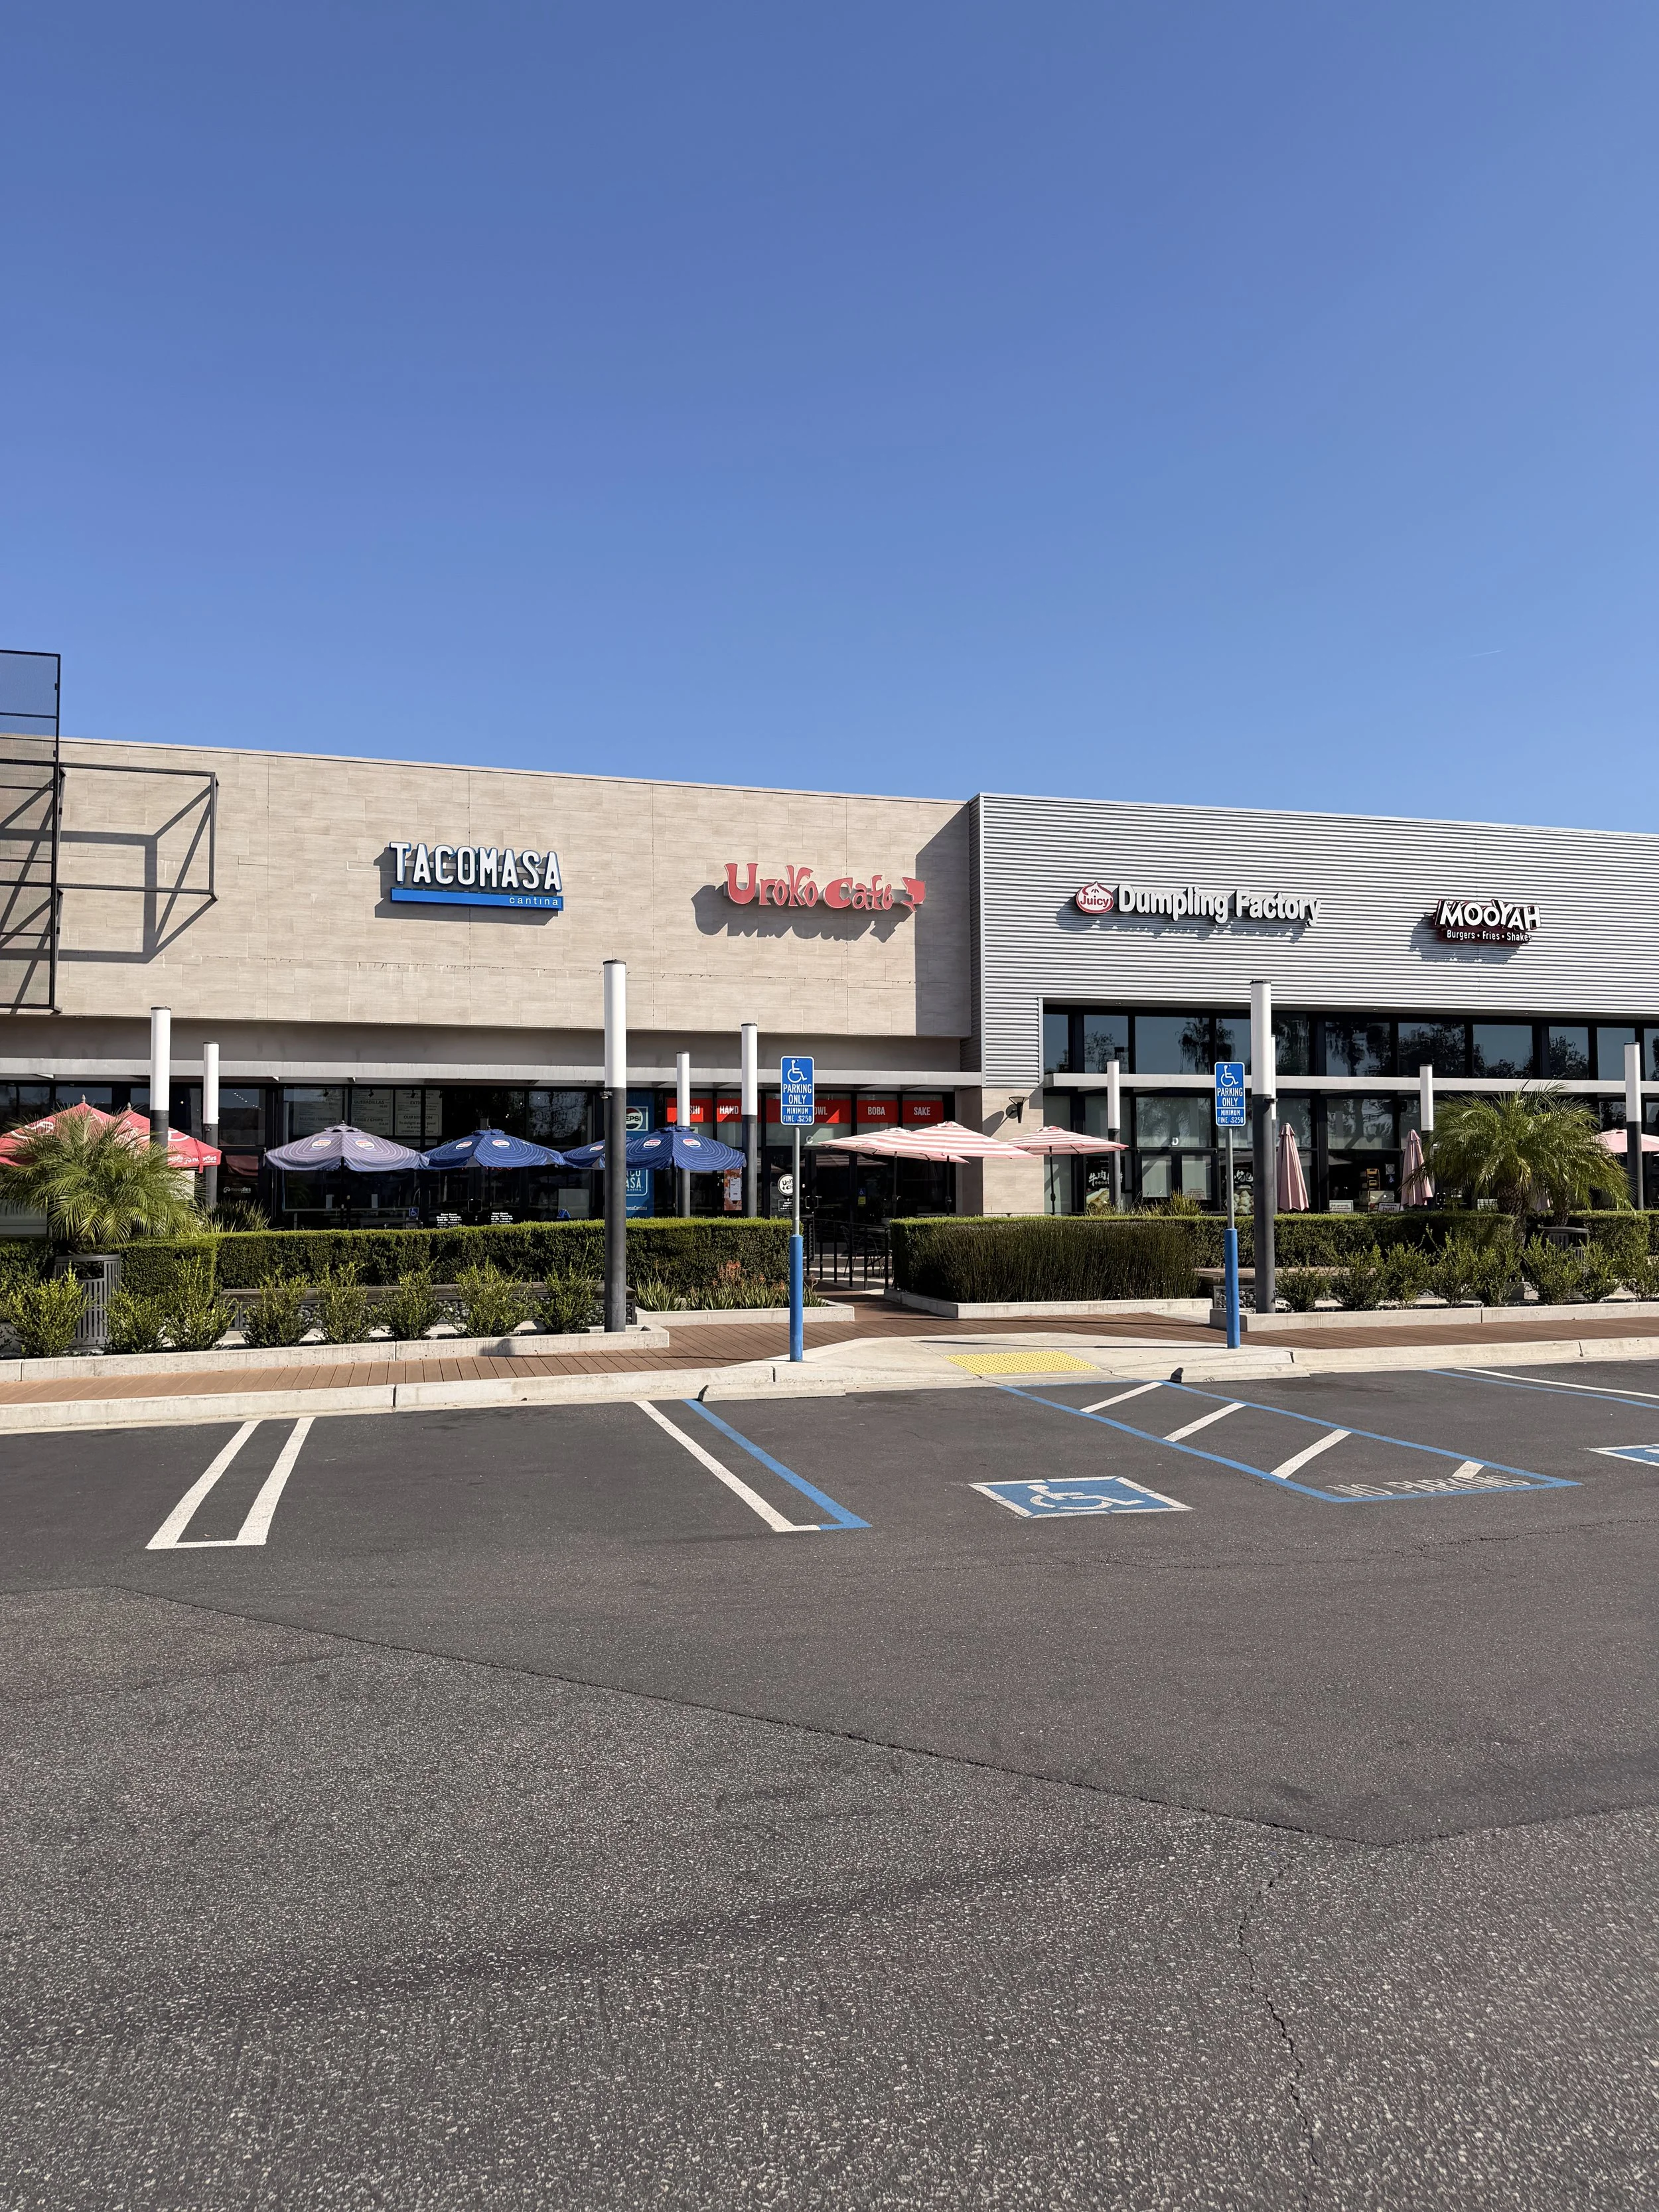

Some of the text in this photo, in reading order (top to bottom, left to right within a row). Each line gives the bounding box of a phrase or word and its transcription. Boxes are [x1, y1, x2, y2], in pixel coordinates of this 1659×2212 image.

[390, 842, 562, 892] TACOMASA
[725, 863, 819, 907] Uroko
[509, 896, 558, 907] cantina
[1080, 895, 1109, 907] Juicy
[1118, 884, 1321, 926] Dumpling Factory
[1436, 899, 1542, 930] MOOYAH
[1447, 929, 1532, 942] Burgers Fries Shakes
[783, 1083, 812, 1094] PARKING
[1217, 1087, 1243, 1097] PARKING
[788, 1094, 806, 1104] ONLY
[1222, 1097, 1238, 1106] ONLY
[719, 1106, 739, 1114] HAND
[867, 1106, 885, 1116] BOBA
[914, 1106, 931, 1116] SAKE
[806, 1136, 814, 1144] C
[1172, 1137, 1179, 1145] D
[1325, 1475, 1531, 1497] NO PARKING
